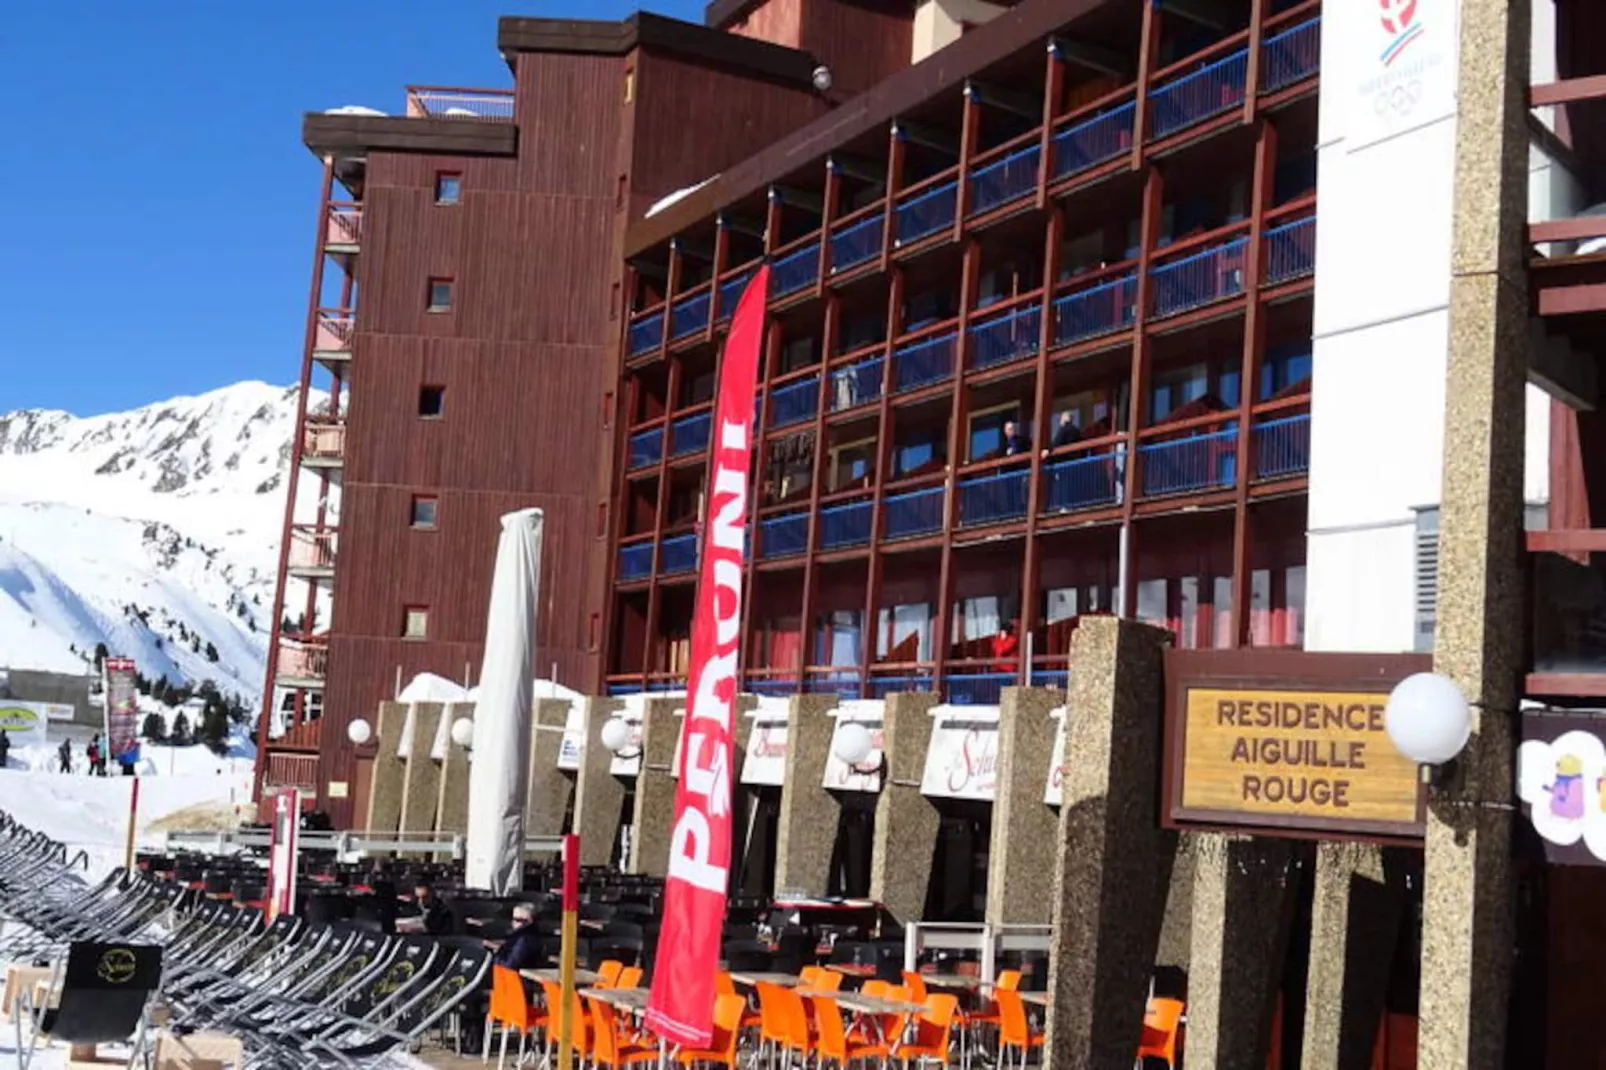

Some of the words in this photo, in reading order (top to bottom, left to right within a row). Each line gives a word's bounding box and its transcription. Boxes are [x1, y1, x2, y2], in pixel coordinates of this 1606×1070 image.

[1217, 700, 1385, 732] RESIDENCE
[1232, 737, 1366, 769] AIGUILLE
[1243, 776, 1350, 808] ROUGE
